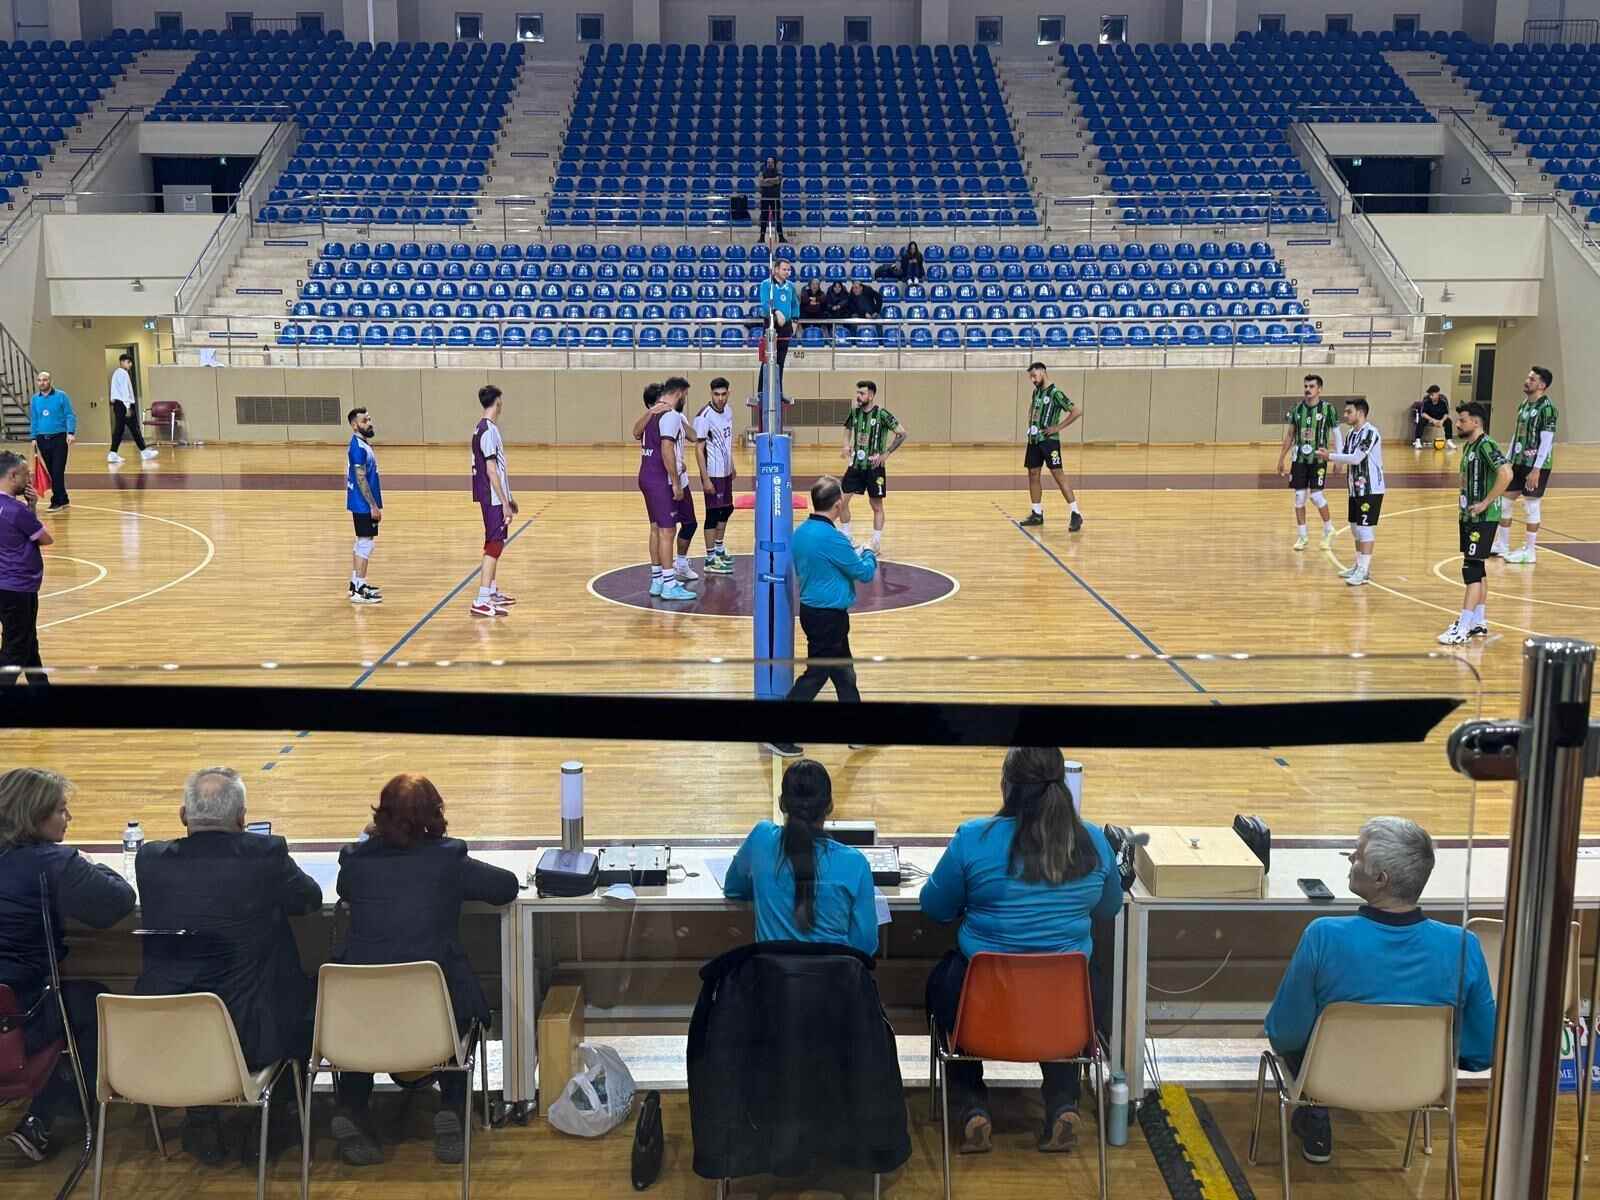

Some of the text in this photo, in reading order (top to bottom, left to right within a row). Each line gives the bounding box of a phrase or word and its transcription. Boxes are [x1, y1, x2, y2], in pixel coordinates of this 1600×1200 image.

[307, 259, 312, 267] E
[1303, 299, 1310, 307] C
[274, 321, 281, 330] B
[1315, 321, 1322, 329] B
[1328, 343, 1335, 351] A
[1361, 514, 1369, 526] 2
[1468, 543, 1477, 556] 9
